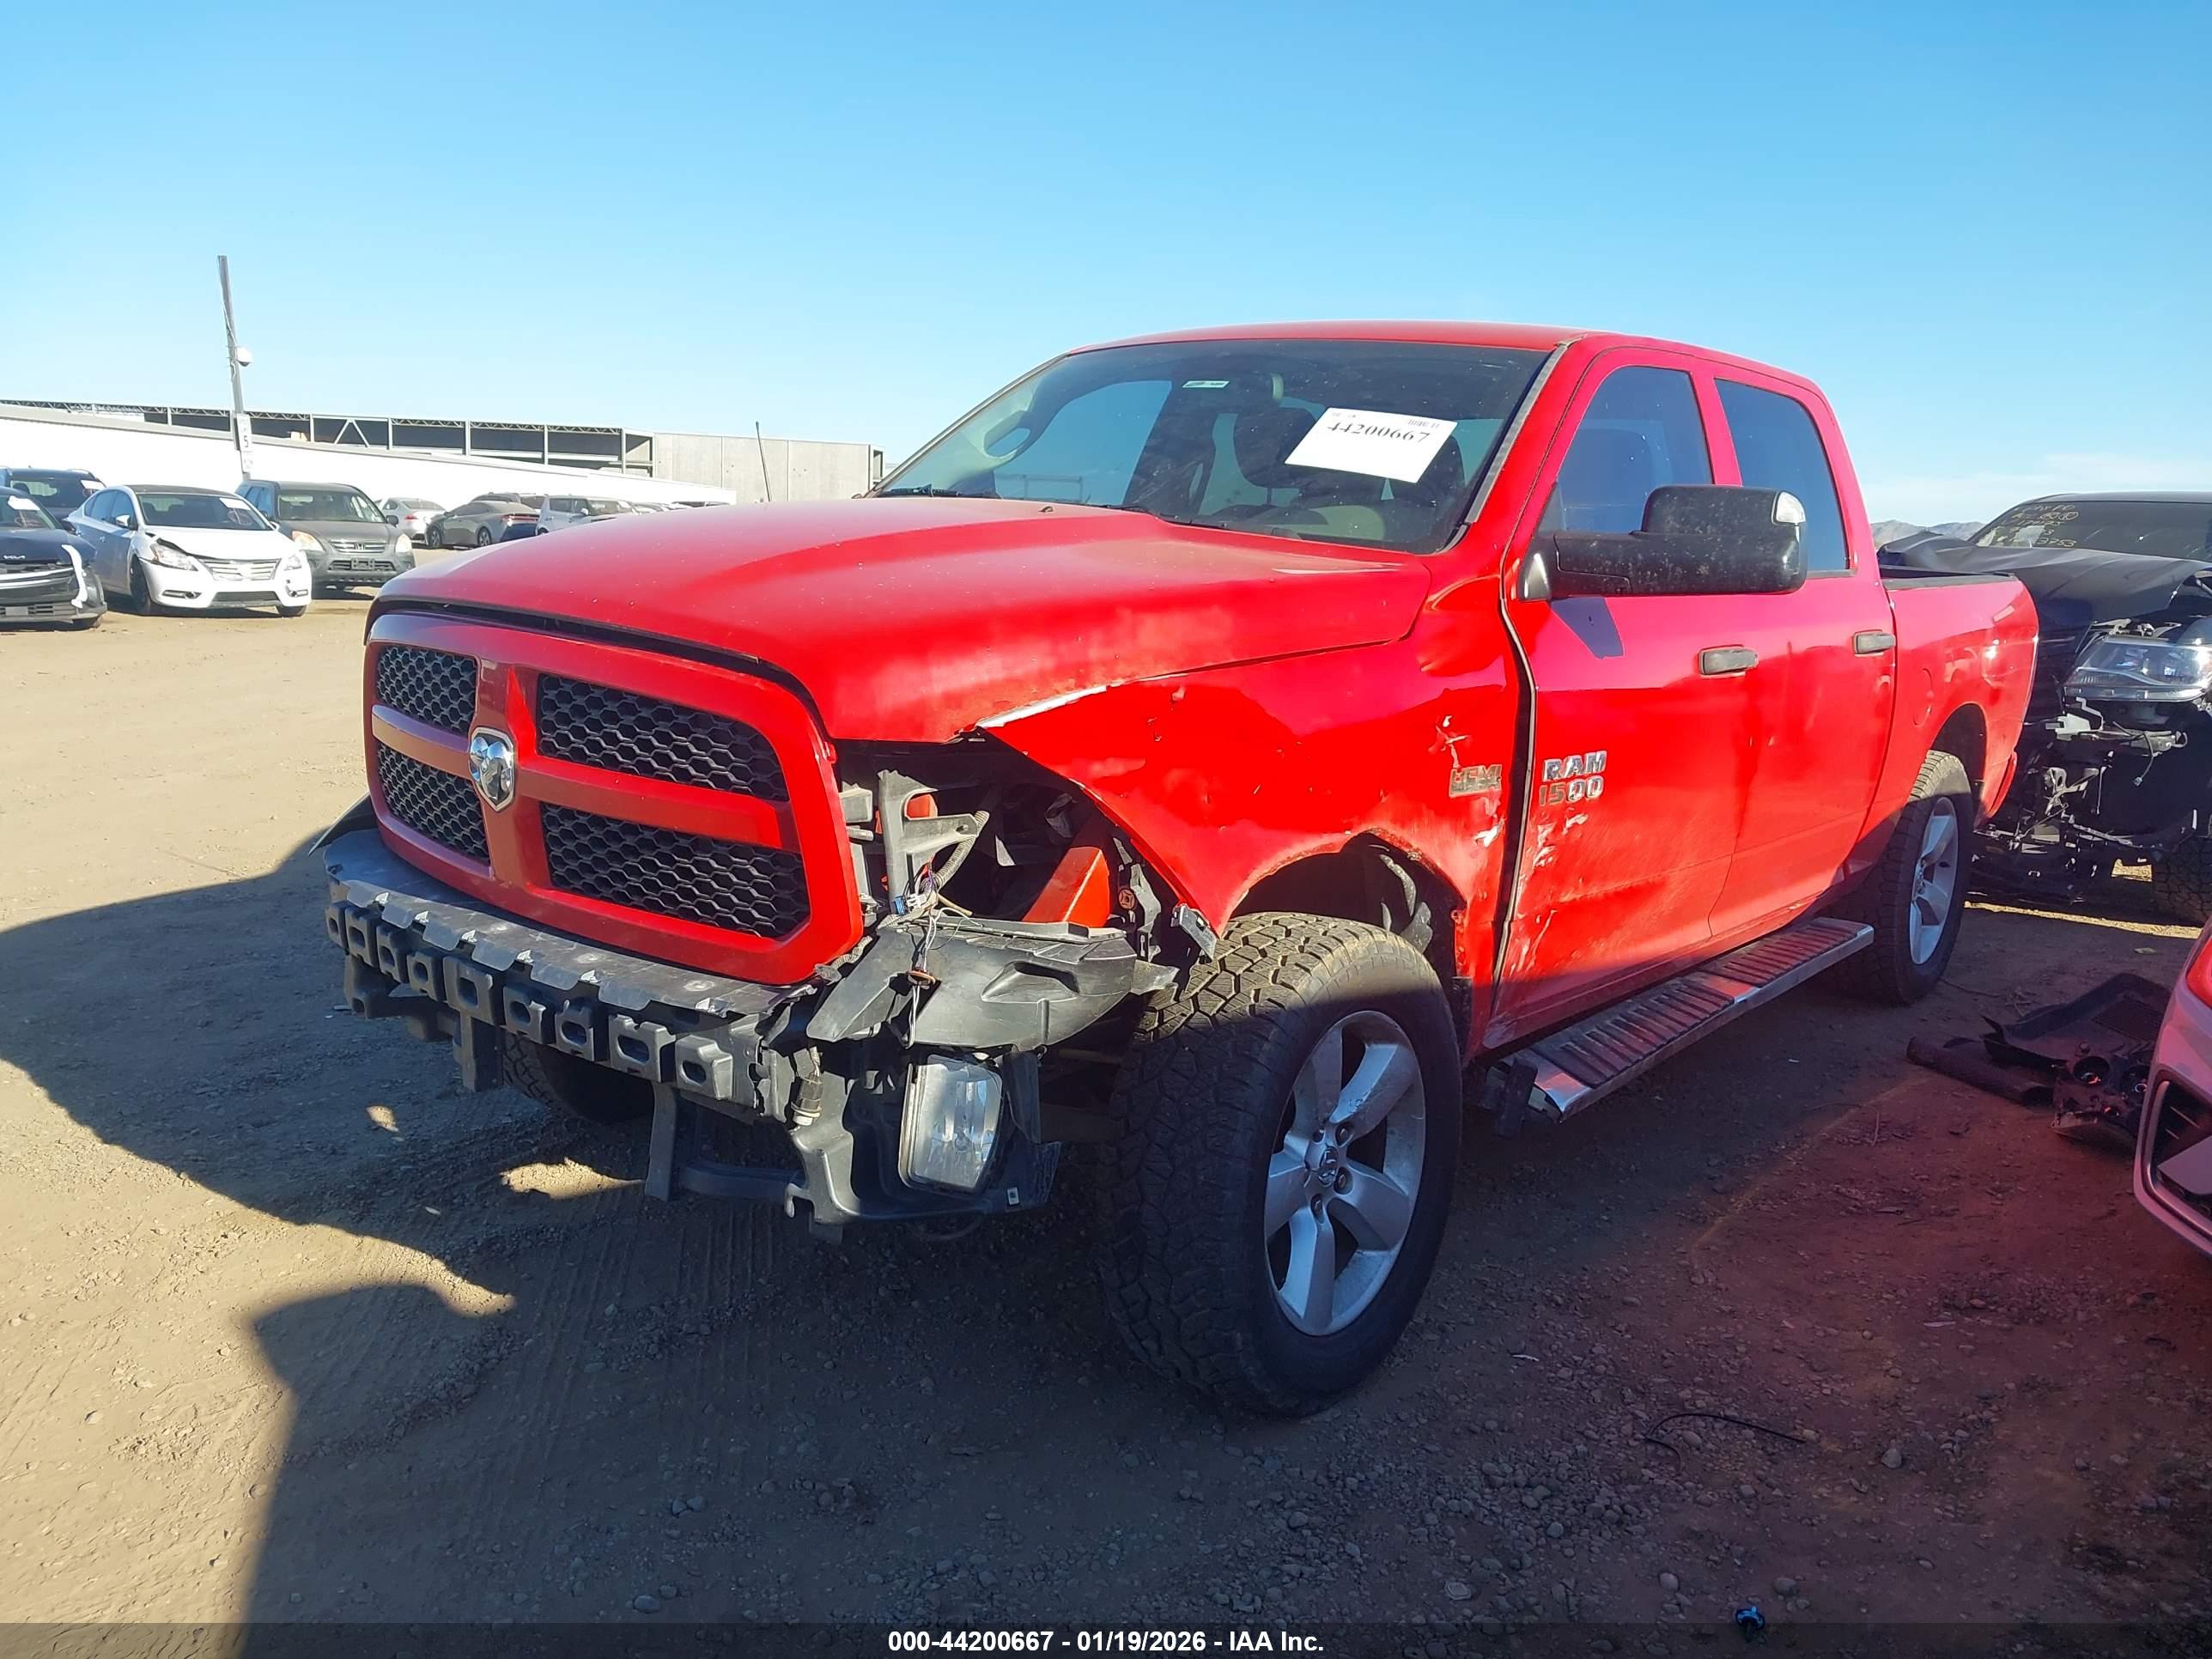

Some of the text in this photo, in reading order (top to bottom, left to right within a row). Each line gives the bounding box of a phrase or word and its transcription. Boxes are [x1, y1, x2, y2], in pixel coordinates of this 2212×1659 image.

[1328, 422, 1431, 442] 44200667
[1542, 750, 1607, 782] RAM
[1539, 775, 1604, 806] 1500
